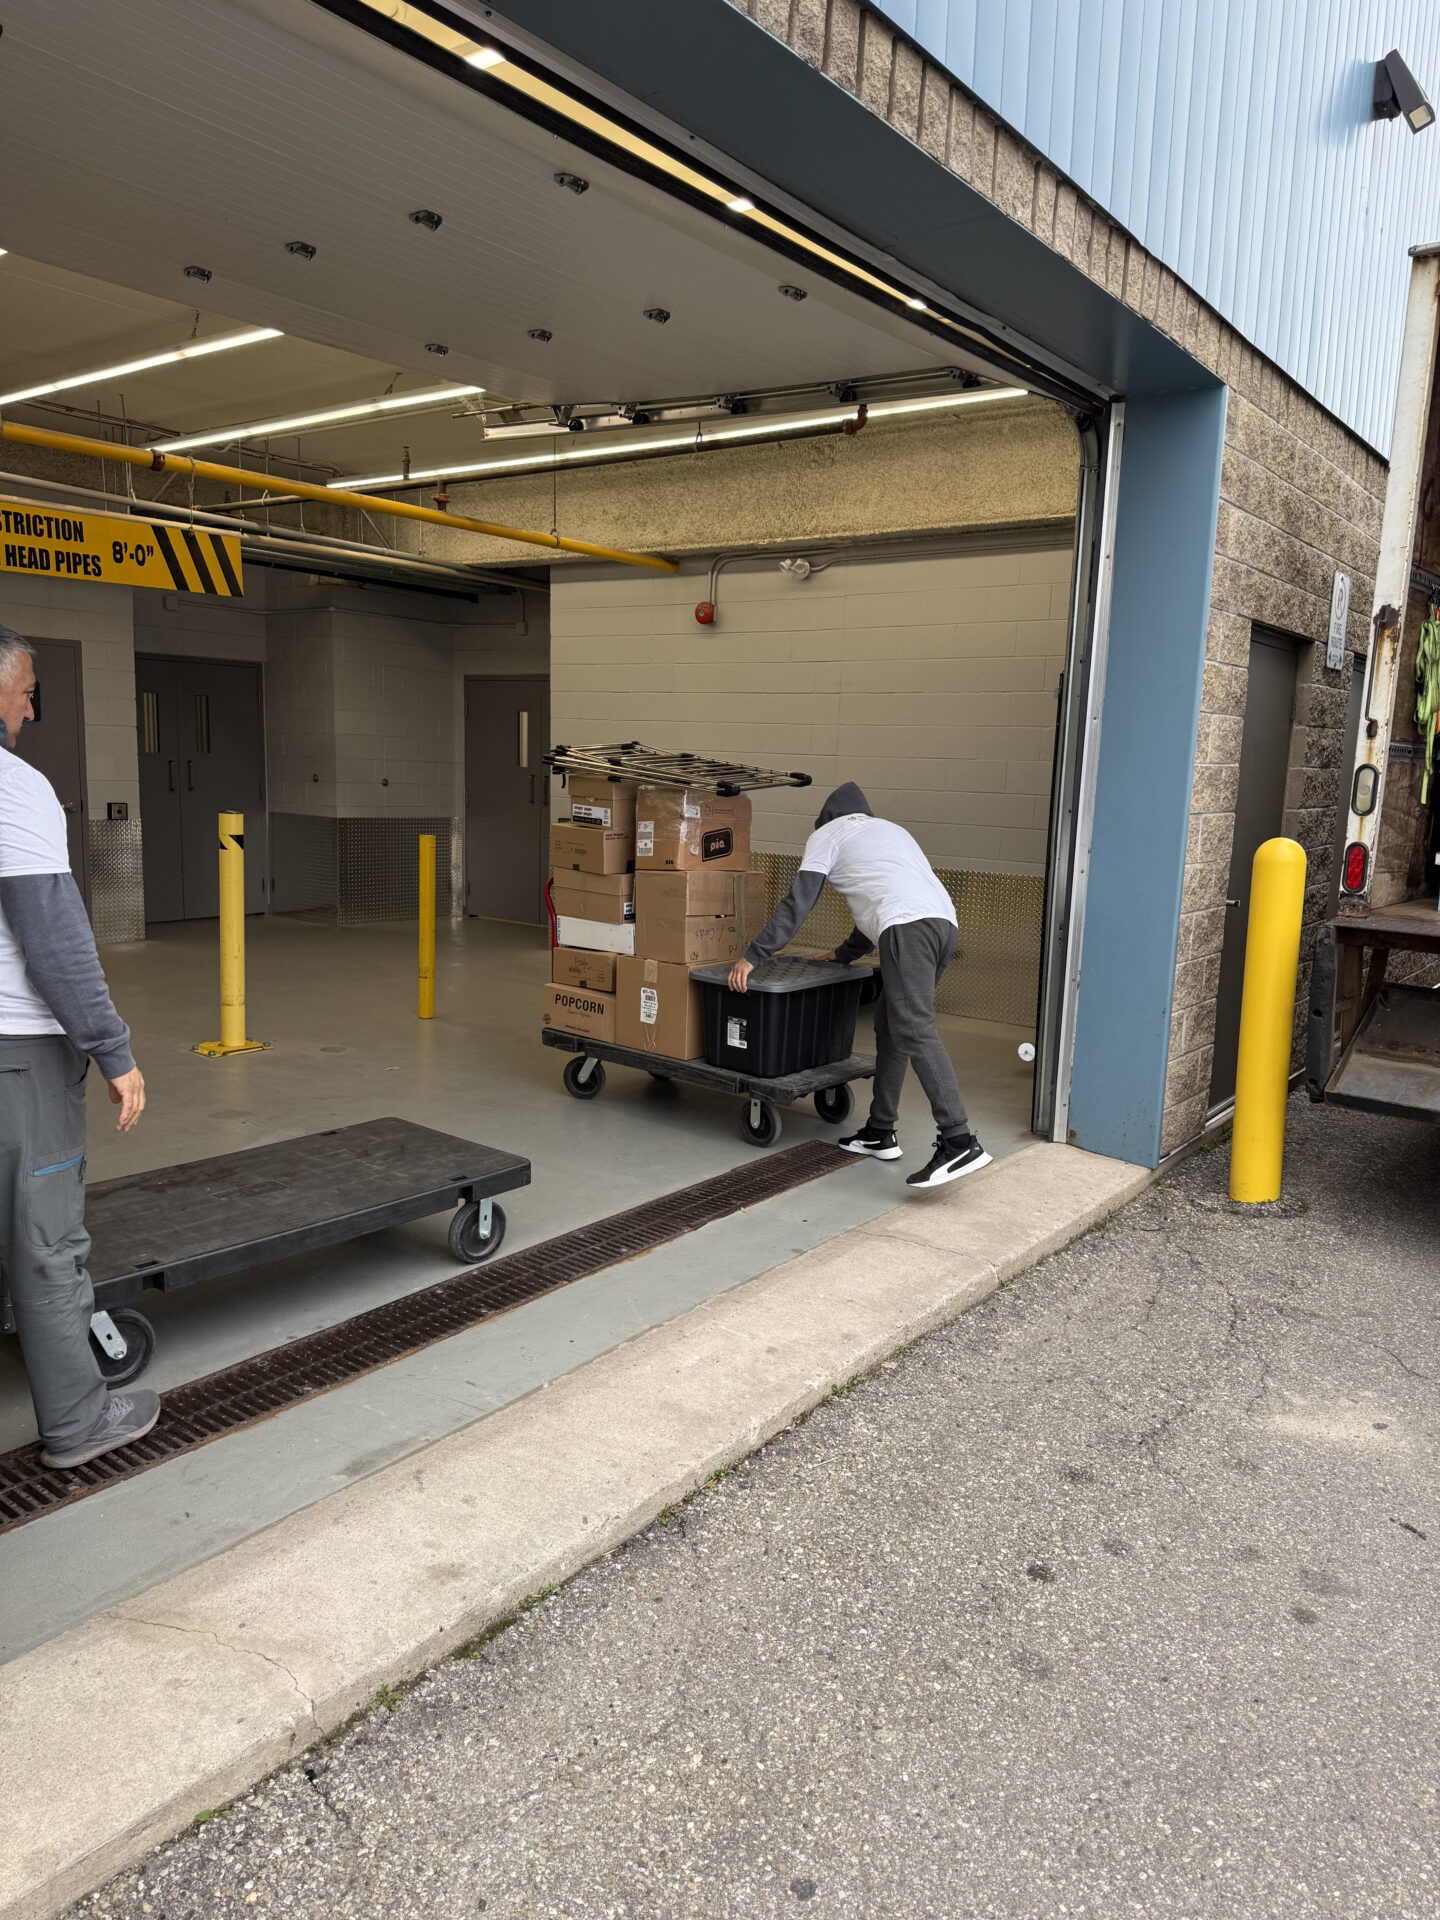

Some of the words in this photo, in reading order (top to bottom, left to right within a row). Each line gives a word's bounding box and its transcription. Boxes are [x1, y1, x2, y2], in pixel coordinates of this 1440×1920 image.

[0, 509, 84, 543] TRICTION
[4, 543, 51, 571] HEAD
[54, 549, 102, 577] PIPES
[554, 993, 605, 1016] POPCORN
